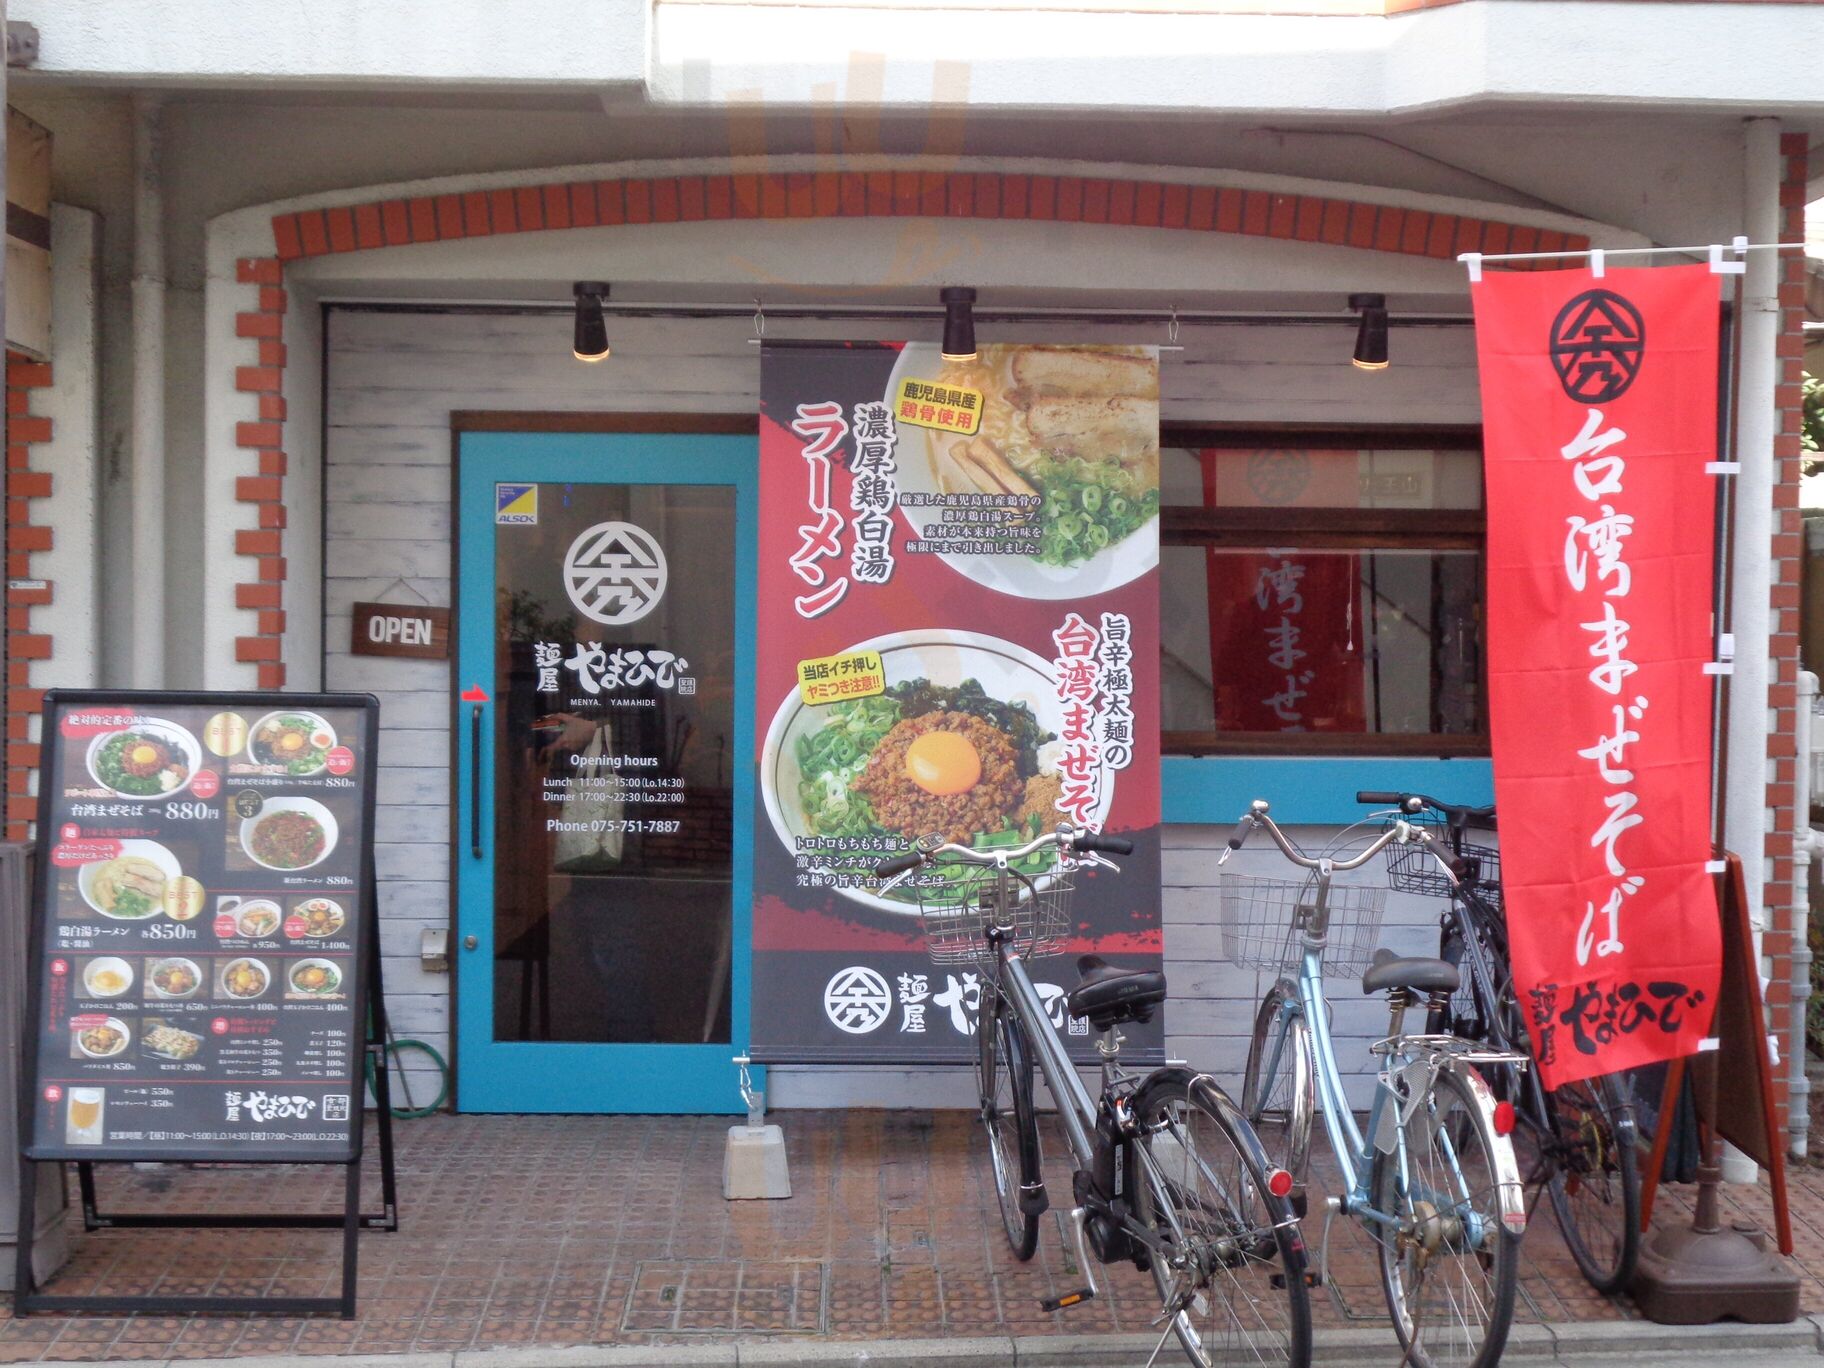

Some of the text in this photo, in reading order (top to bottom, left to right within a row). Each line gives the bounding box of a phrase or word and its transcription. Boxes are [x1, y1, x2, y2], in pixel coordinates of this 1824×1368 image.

[903, 381, 977, 409] 鹿児島県産
[900, 400, 973, 430] 鶏骨使用
[852, 402, 896, 582] 濃厚鶏白湯
[901, 493, 1041, 507] 厳選した鹿児島県産鶏骨の
[789, 401, 848, 618] ラーメン
[943, 510, 1042, 523] 濃厚鶏白湯スープ。
[923, 526, 1041, 539] 素材が本来持つ旨味を
[906, 542, 1042, 555] 極限にまで引き出しました。
[369, 615, 432, 645] OPEN
[565, 641, 689, 694] やまひで
[803, 658, 877, 681] 当店イチ押し
[1102, 615, 1131, 766] 旨辛極太麺の
[1560, 407, 1648, 965] 台湾まぜそば
[611, 698, 656, 707] YAMAHIDE
[570, 754, 658, 767] Opening hours
[543, 778, 572, 788] Lunch
[543, 792, 575, 802] Dinner
[71, 804, 144, 817] 台湾まぜそば
[165, 802, 219, 820] 880円
[547, 820, 680, 833] Phone 075-751-7887
[796, 837, 909, 851] トロトロもちもち麺と
[58, 925, 130, 937] 鶏白湯ラーメン
[897, 972, 929, 1033] 麺屋
[1561, 981, 1706, 1056] やまひで
[243, 1091, 316, 1123] やまひで
